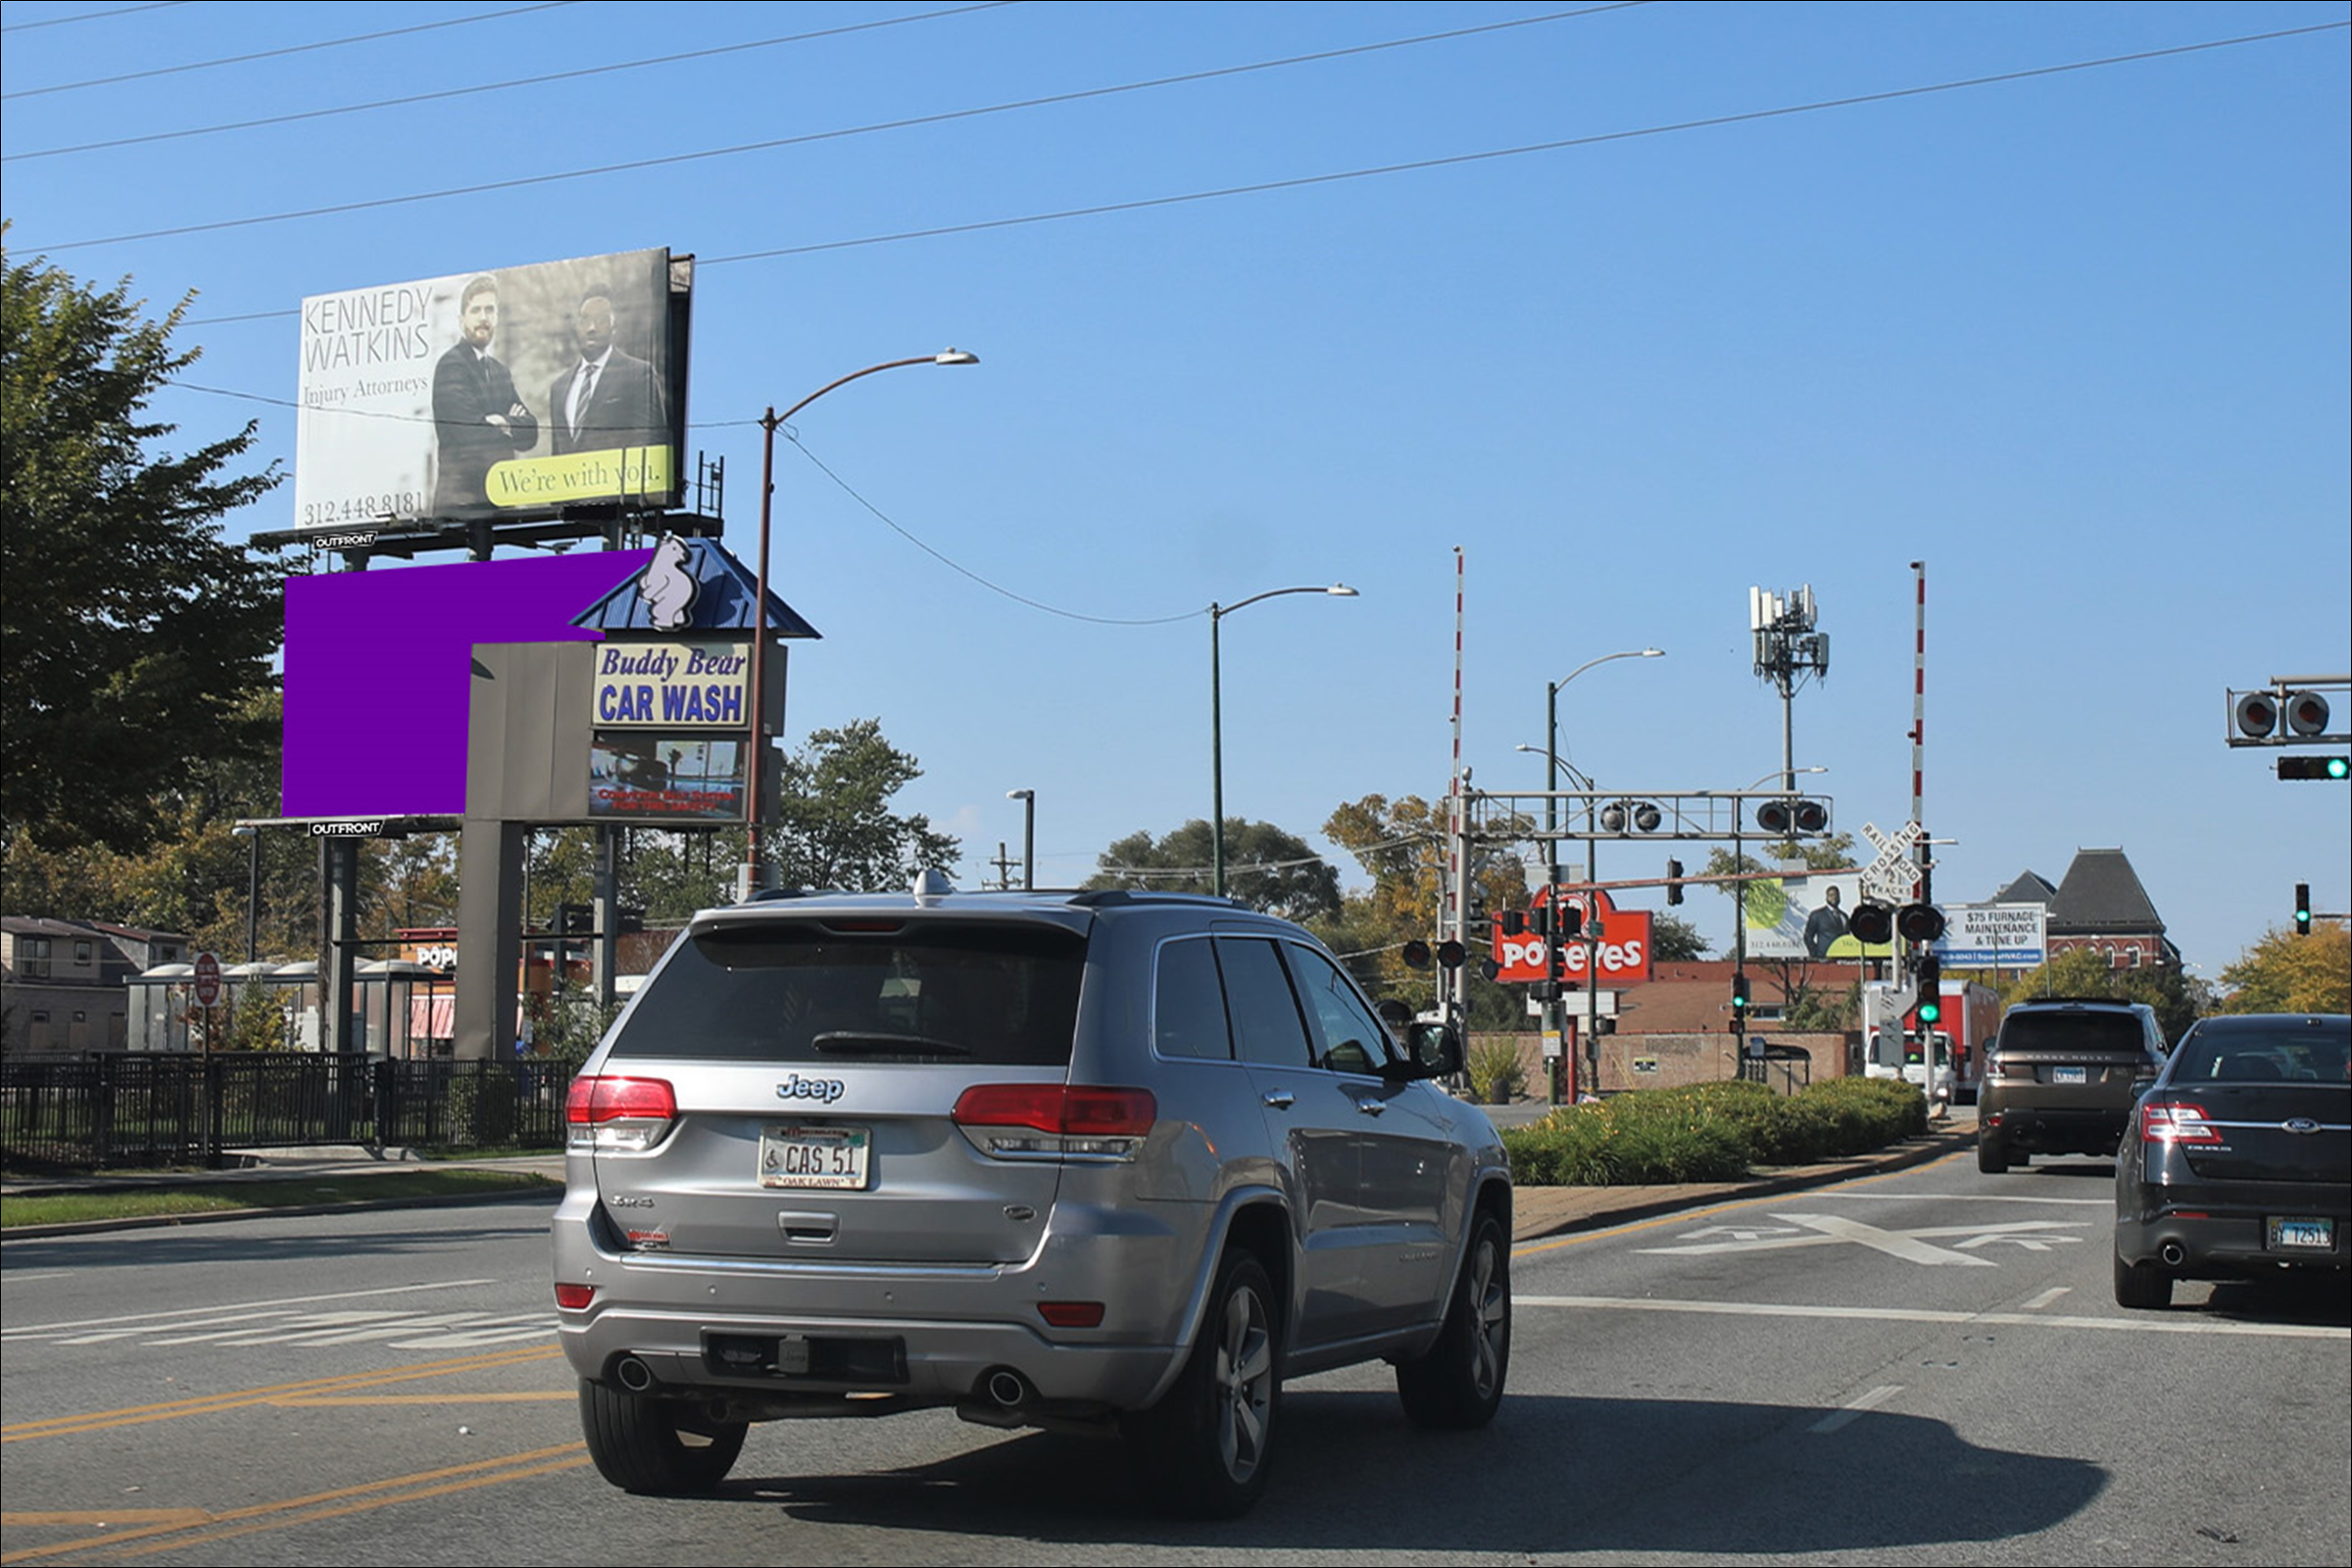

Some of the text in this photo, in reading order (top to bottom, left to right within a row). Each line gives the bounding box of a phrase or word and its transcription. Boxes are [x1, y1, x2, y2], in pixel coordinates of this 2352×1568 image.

[305, 286, 432, 336] KENNEDY
[305, 323, 428, 372] WATKINS
[304, 376, 428, 407] Injury Attorneys
[563, 462, 609, 489] with
[304, 491, 423, 526] 312.4488181
[316, 534, 373, 548] OUTFRONT
[600, 648, 746, 683] Buddy Bear
[599, 684, 742, 722] CAR WASH
[313, 822, 380, 835] OUTFRONT
[1862, 824, 1886, 853] RAIL
[1863, 824, 1918, 882] CROSSING
[1965, 923, 2038, 934] MAINTENANCE
[1967, 911, 1986, 922] $75
[1975, 935, 2029, 946] & TUNE UP
[777, 1074, 845, 1104] Jeep
[786, 1146, 856, 1175] CAS 51
[783, 1177, 806, 1186] OAK
[808, 1177, 841, 1187] LAWN
